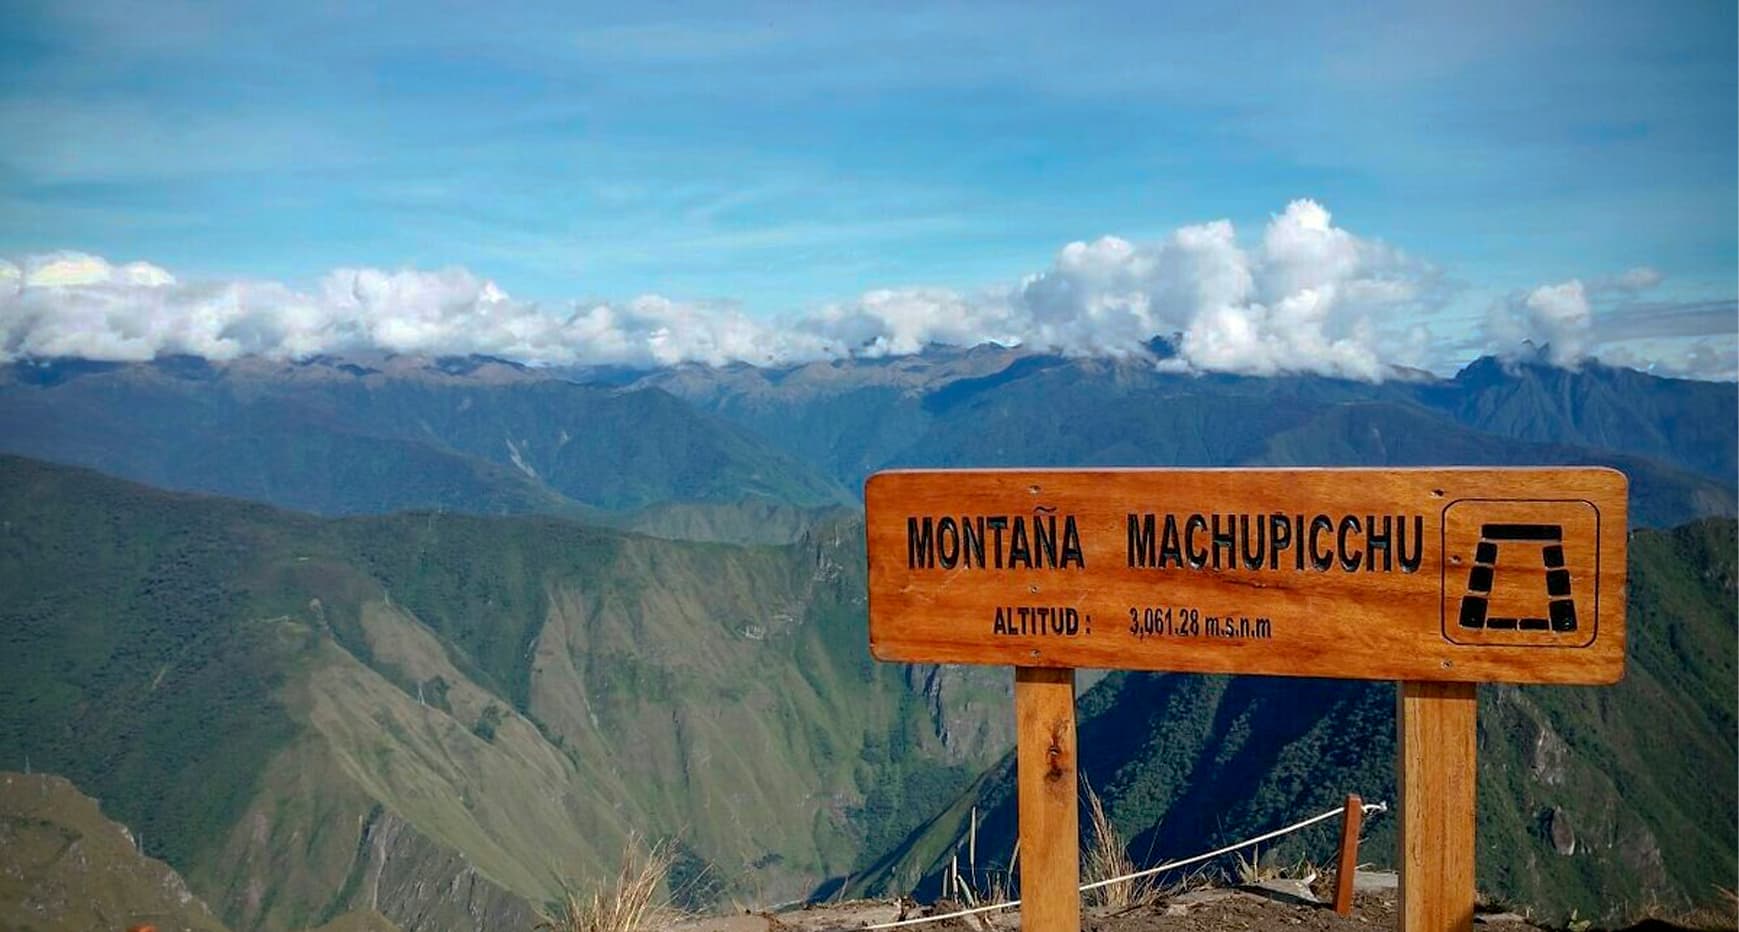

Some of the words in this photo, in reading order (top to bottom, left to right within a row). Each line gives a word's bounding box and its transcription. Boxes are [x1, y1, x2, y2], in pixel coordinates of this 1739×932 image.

[907, 506, 1085, 571] MONTAÑA
[1127, 512, 1424, 574] MACHUPICCHU
[1129, 607, 1200, 639] 3,061.28
[1205, 617, 1272, 639] m.s.n.m
